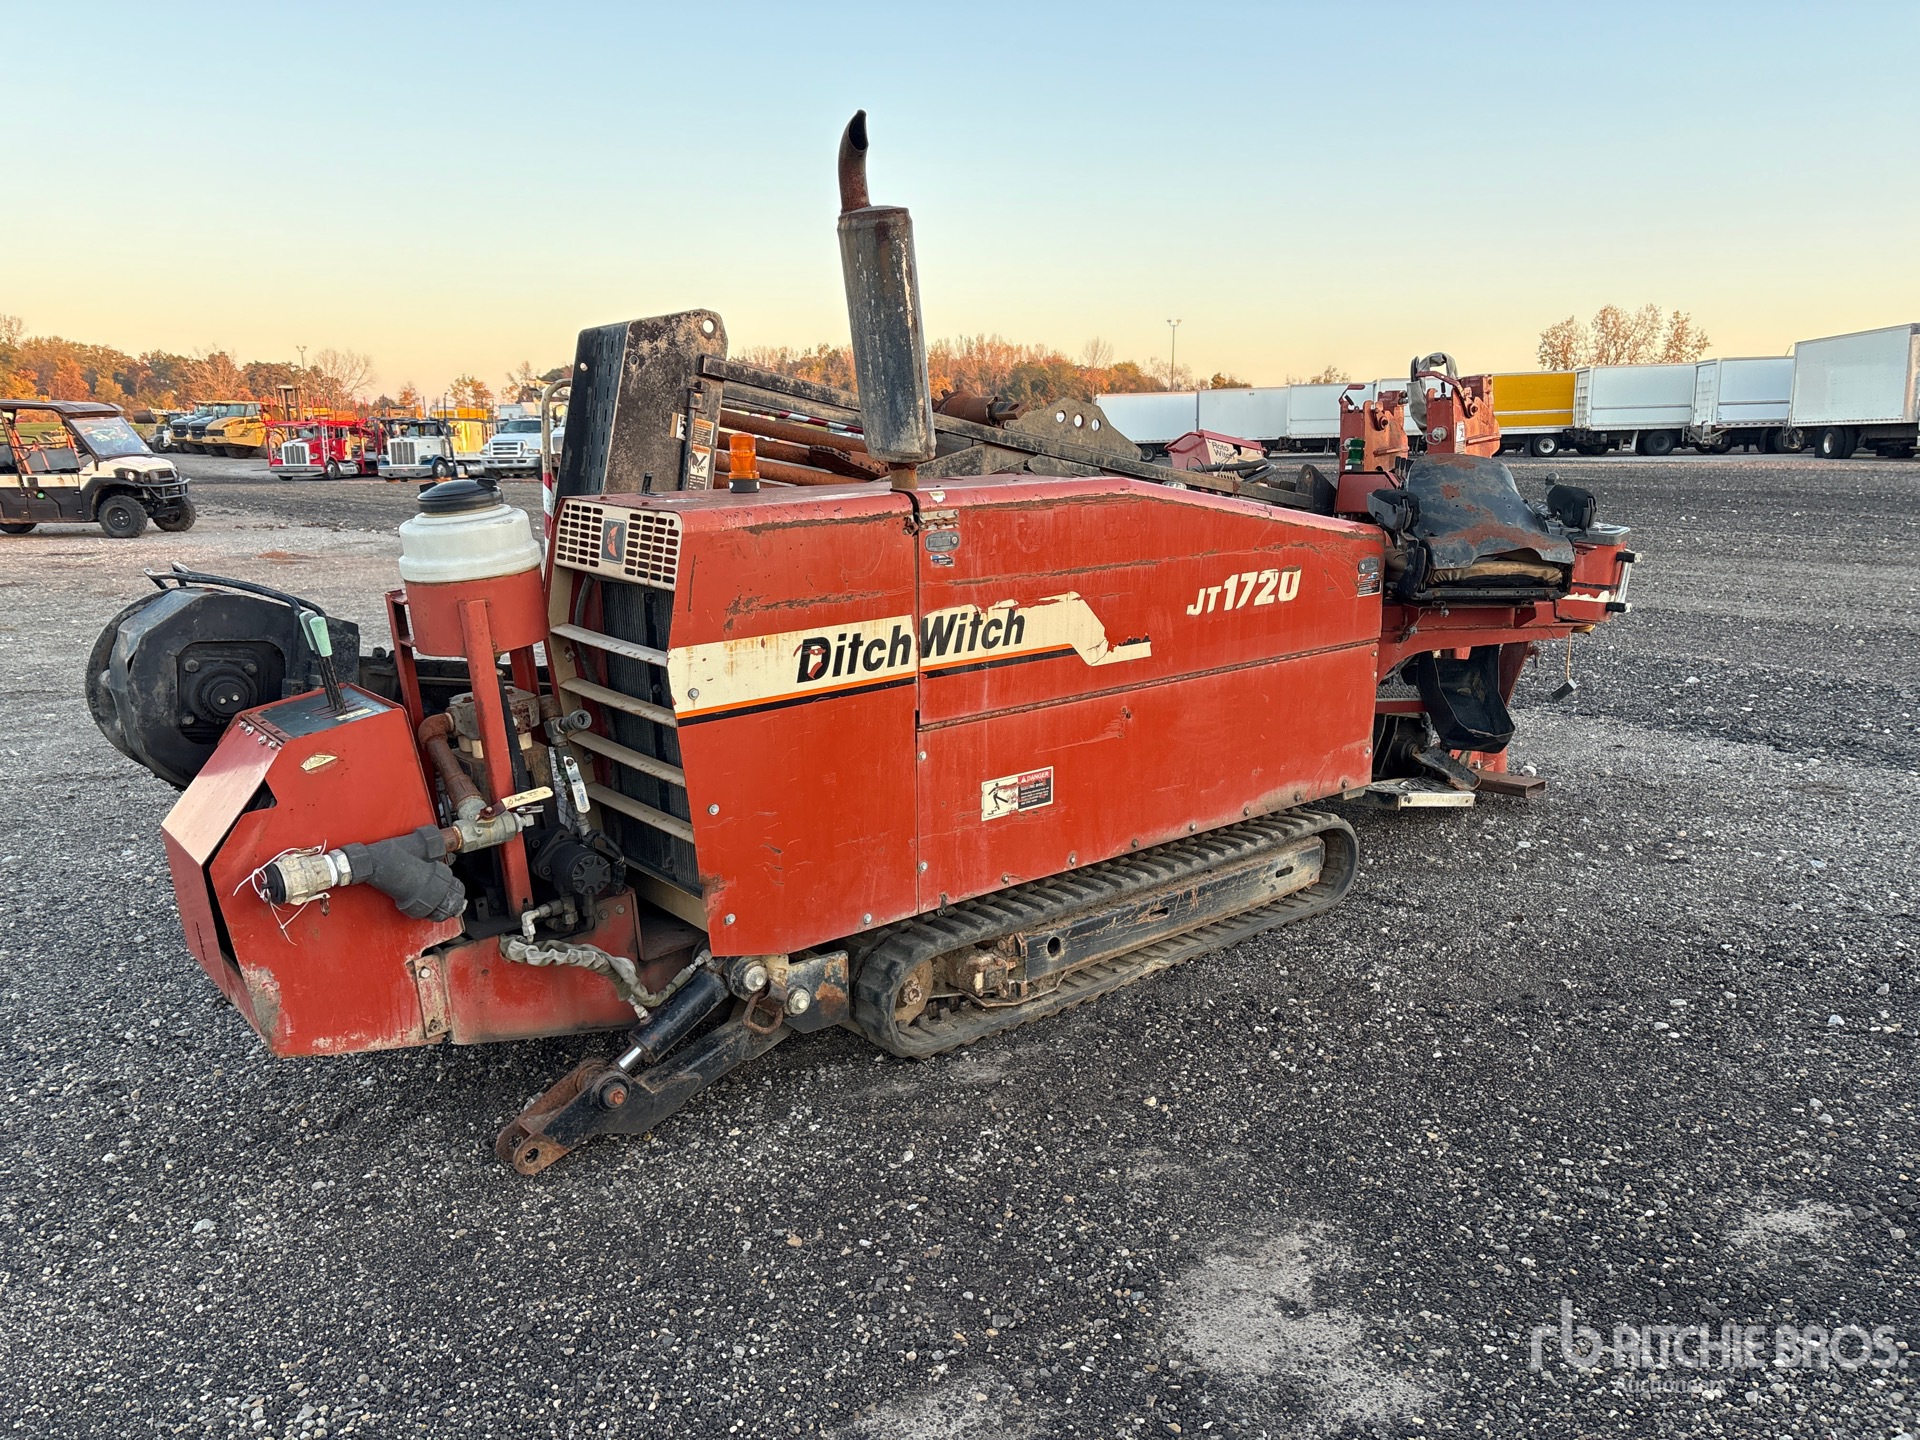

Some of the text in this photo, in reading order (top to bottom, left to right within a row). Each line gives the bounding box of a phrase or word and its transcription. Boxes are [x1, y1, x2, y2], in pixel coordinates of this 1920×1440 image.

[1186, 566, 1302, 616] JT1720
[796, 609, 1026, 684] Ditch Witch
[1026, 771, 1049, 783] DANGER
